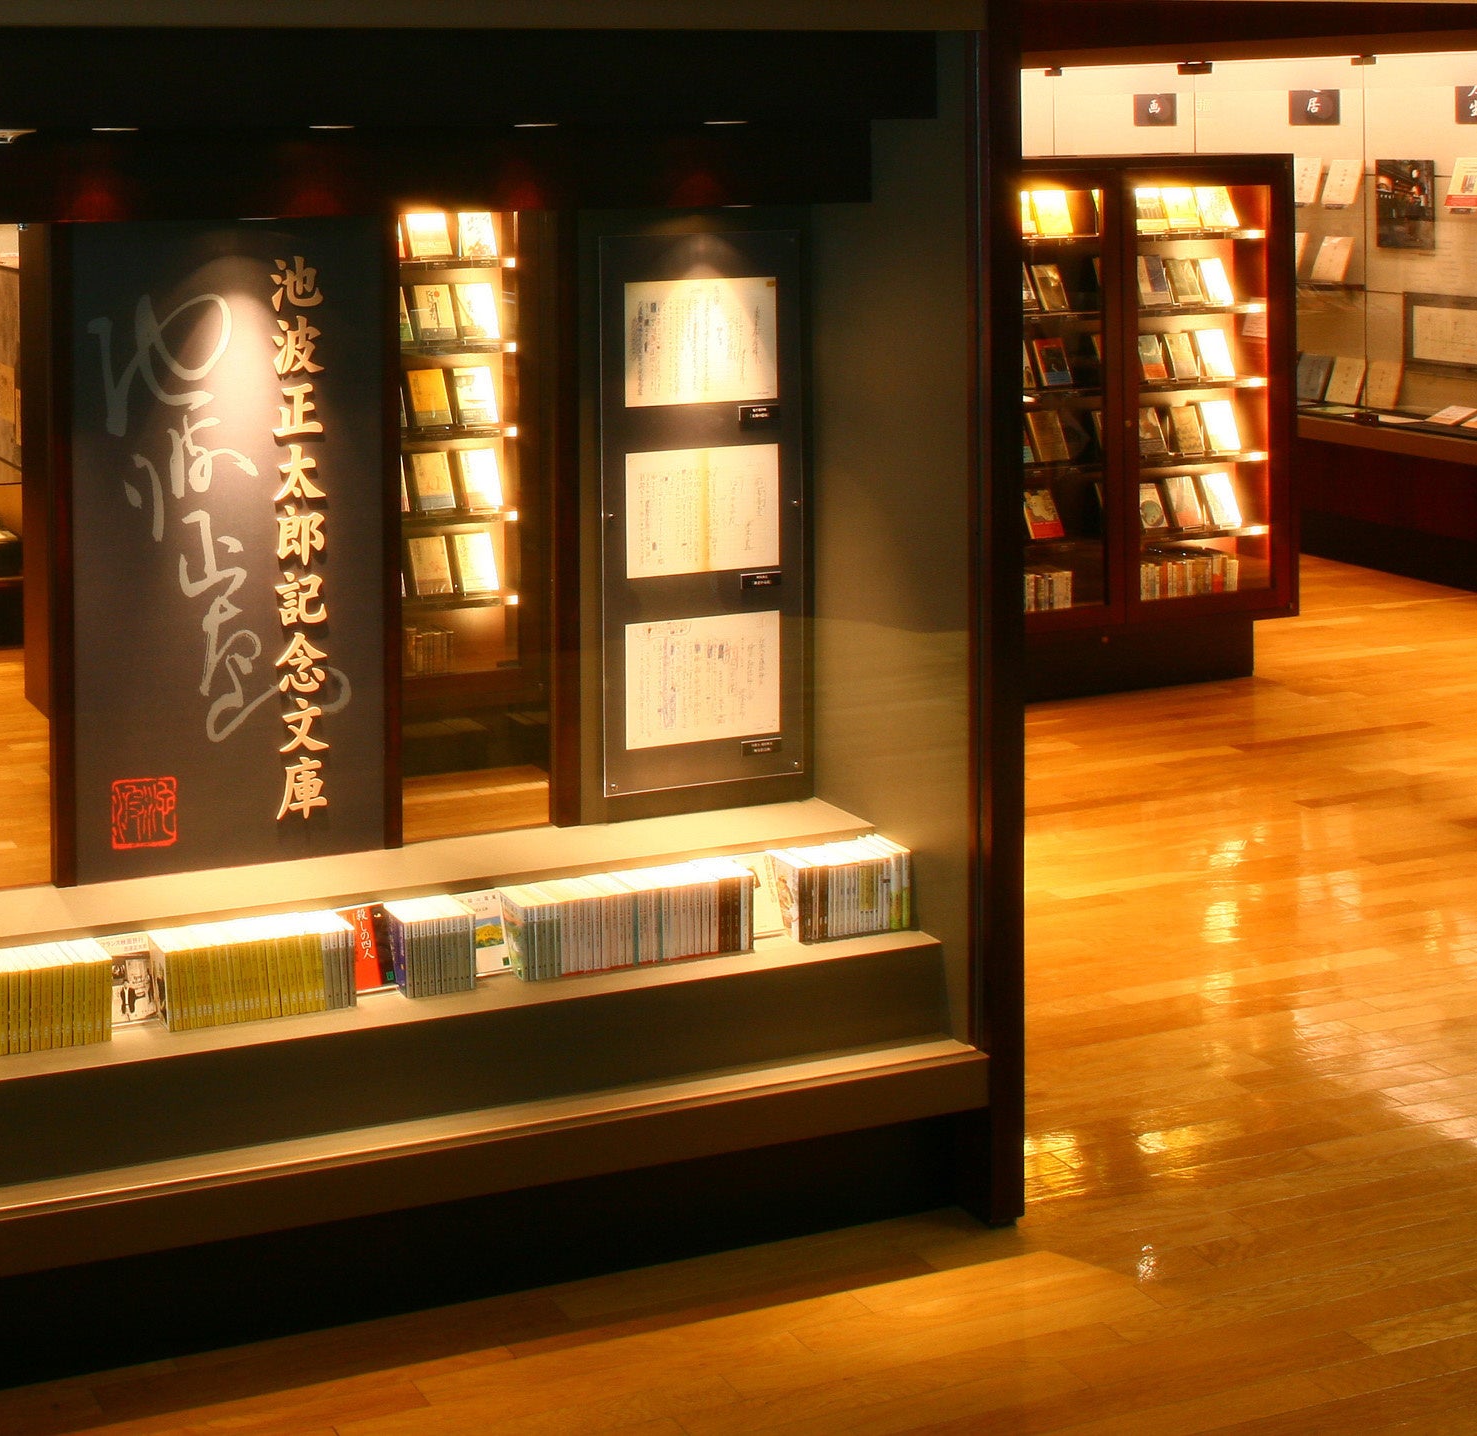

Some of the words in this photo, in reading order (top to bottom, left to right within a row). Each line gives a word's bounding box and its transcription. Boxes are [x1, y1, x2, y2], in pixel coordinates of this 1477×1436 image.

[1148, 94, 1161, 114] 画
[1307, 89, 1321, 113] 居
[270, 257, 330, 821] 池波正太郎記念文庫
[356, 908, 375, 960] 殺しの四人
